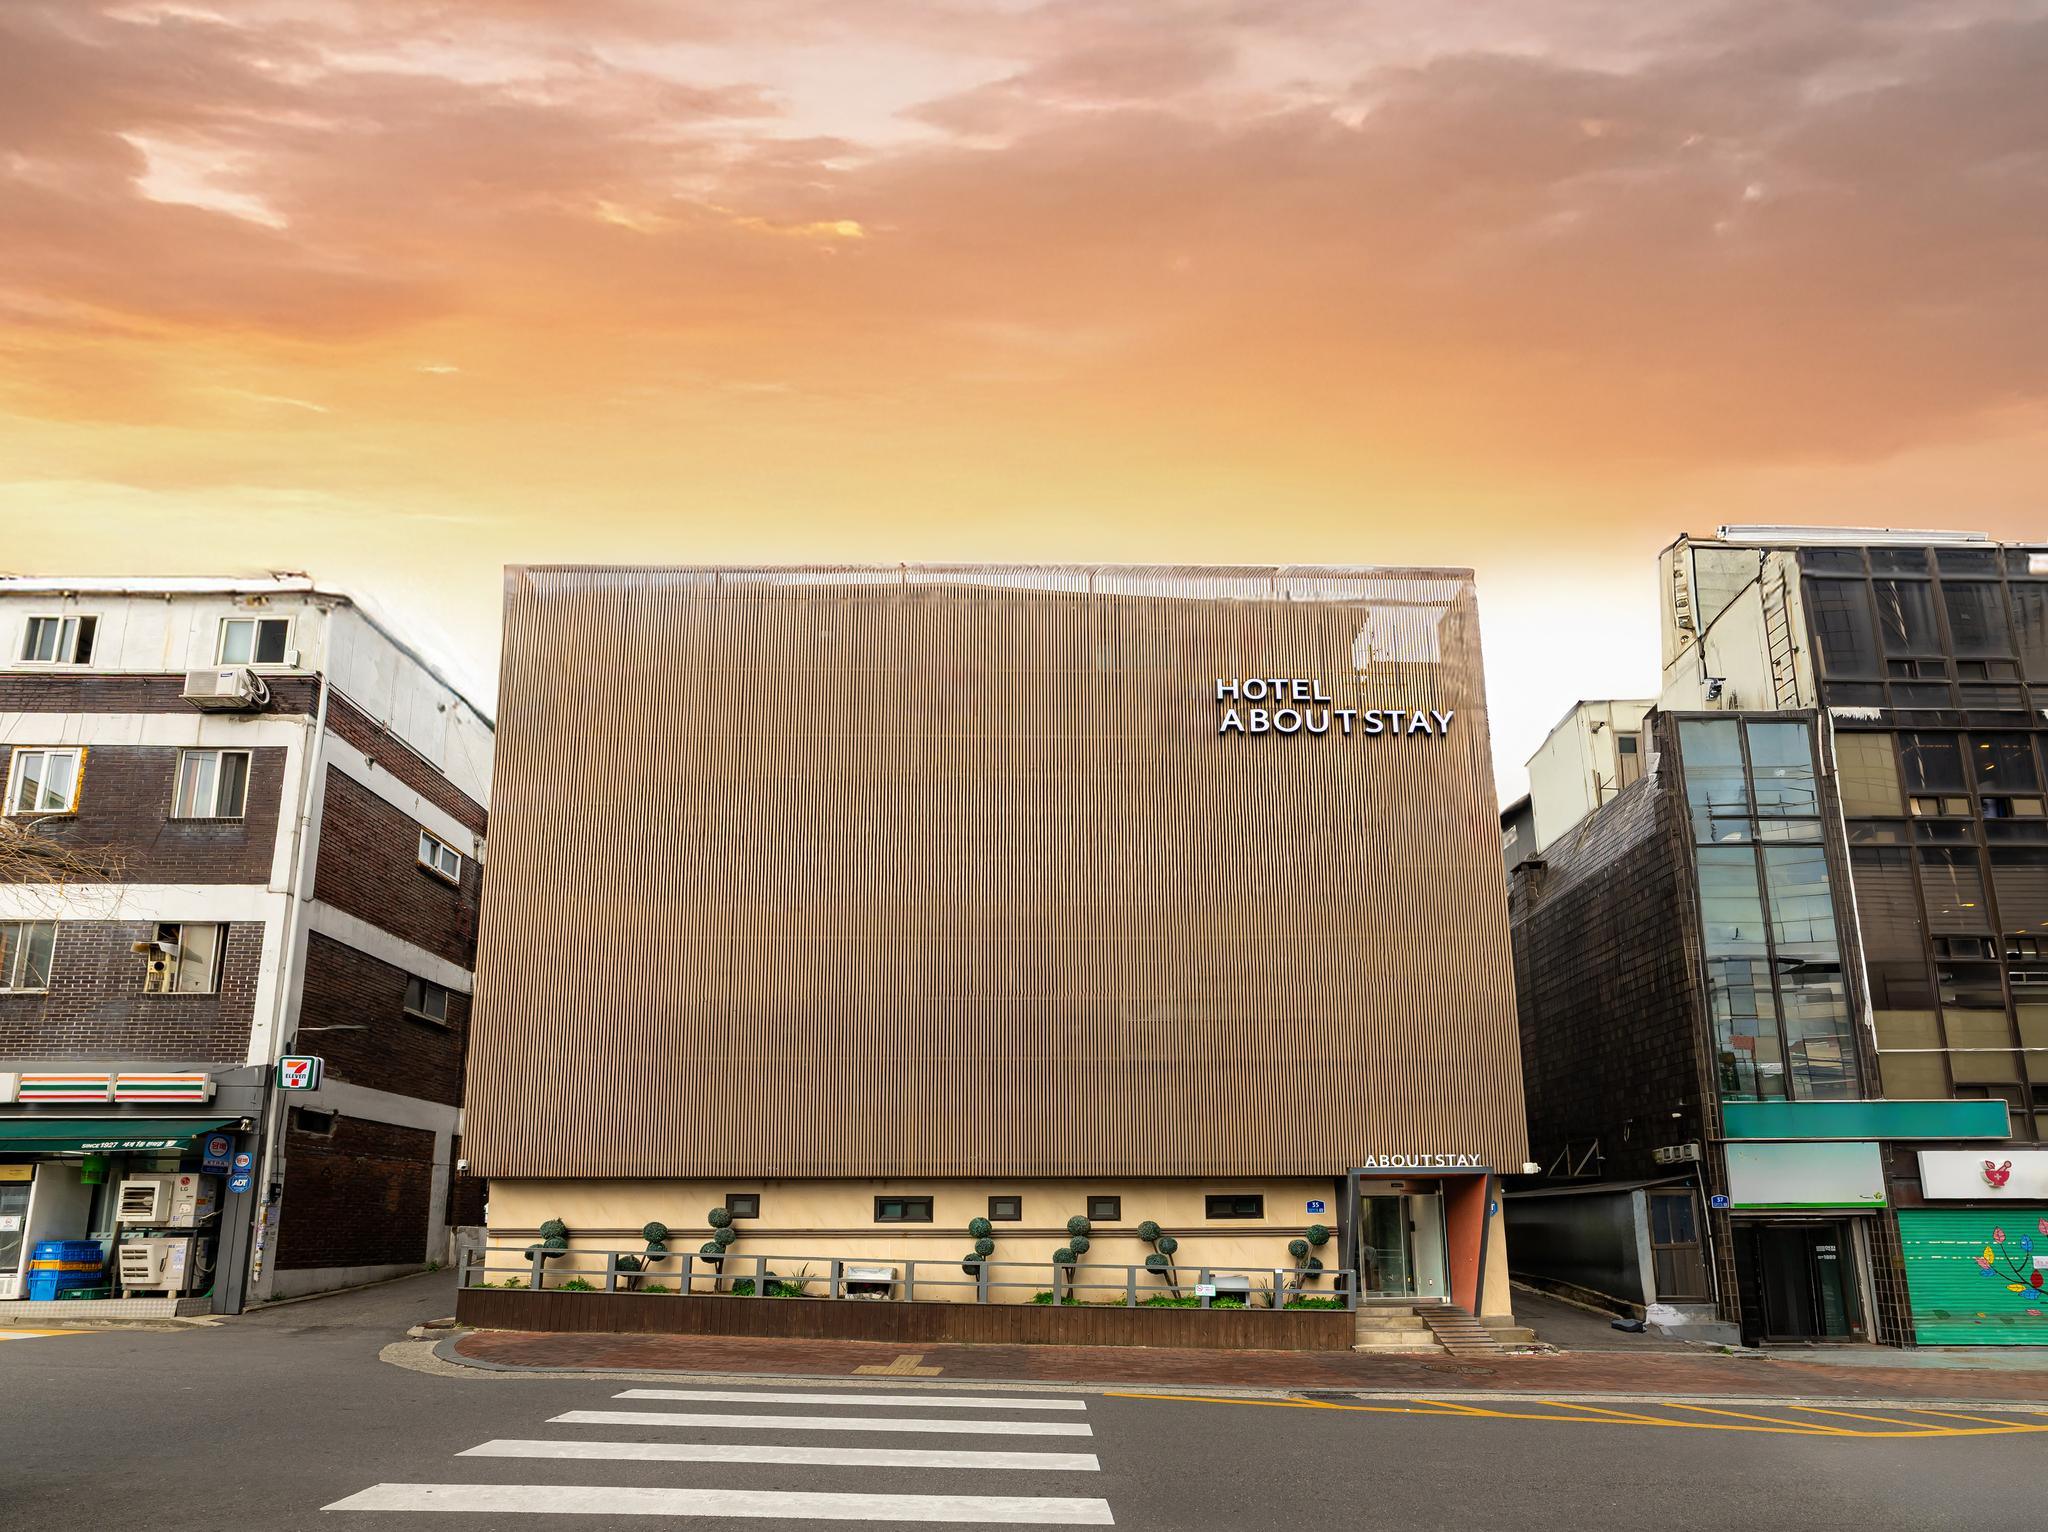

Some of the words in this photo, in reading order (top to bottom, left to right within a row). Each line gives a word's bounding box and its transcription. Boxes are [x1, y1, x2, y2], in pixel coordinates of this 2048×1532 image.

[1216, 677, 1331, 702] HOTEL
[287, 1061, 308, 1086] 7
[231, 1179, 249, 1187] ADT
